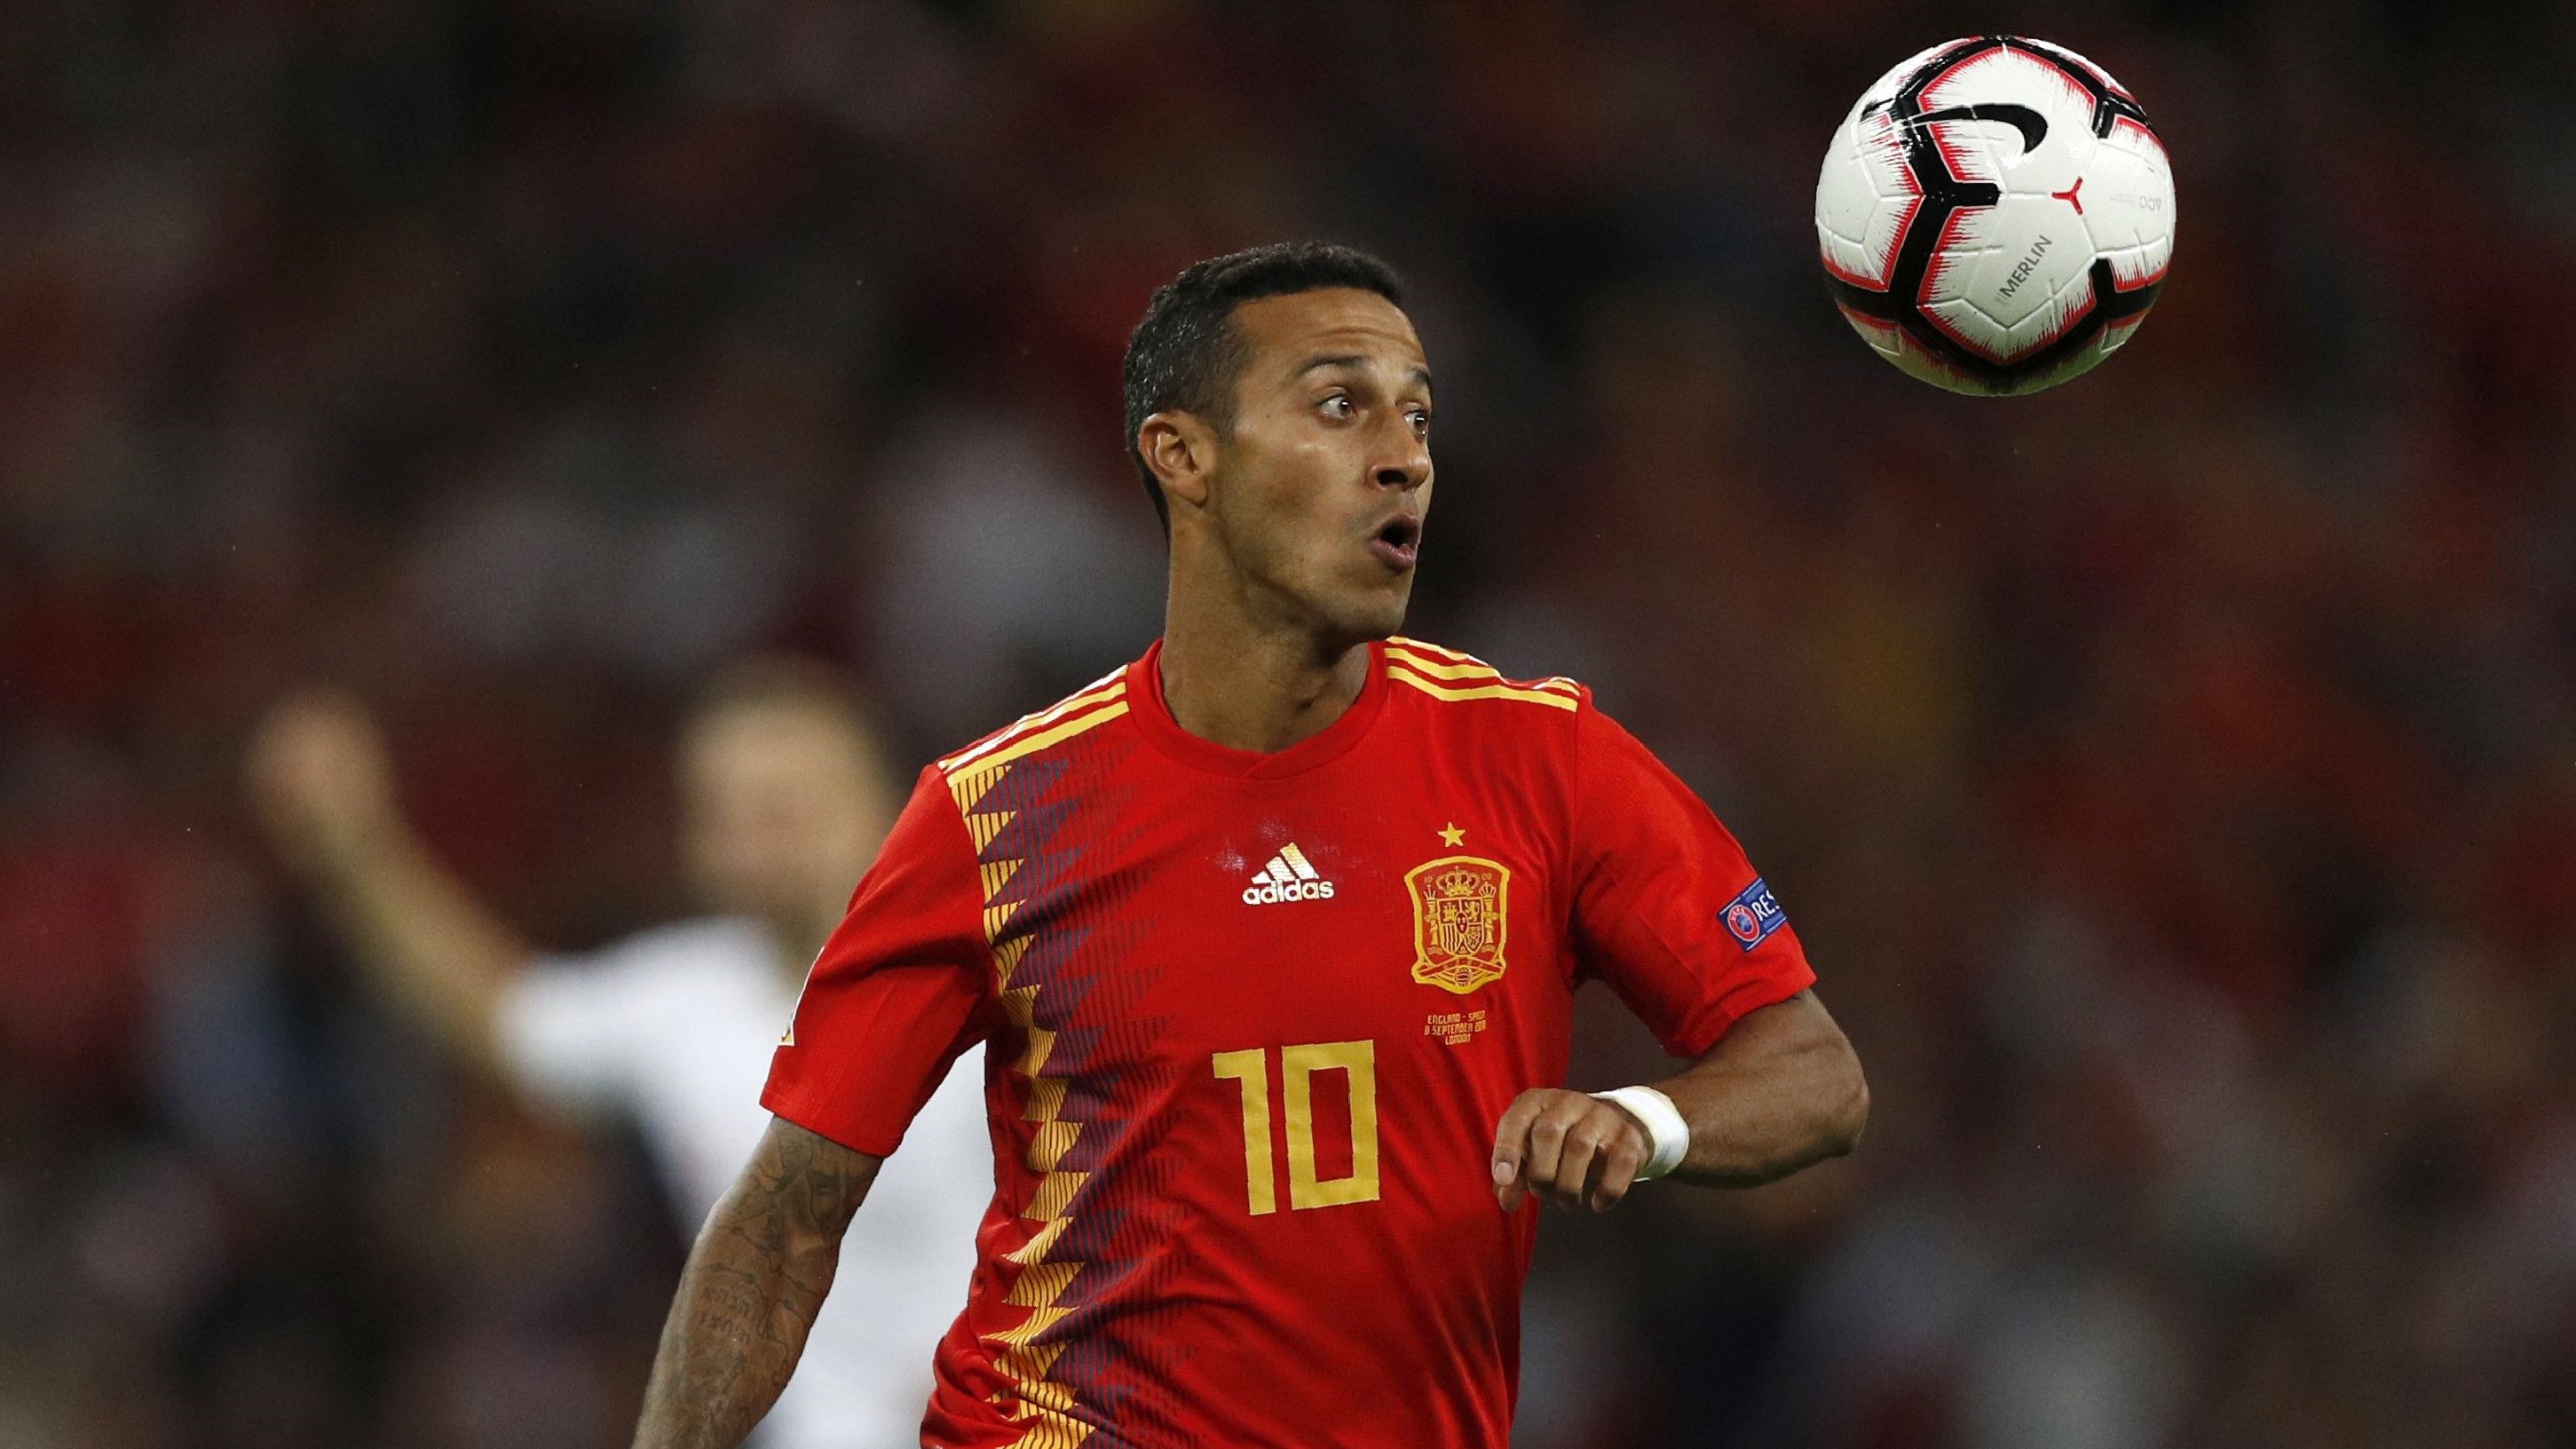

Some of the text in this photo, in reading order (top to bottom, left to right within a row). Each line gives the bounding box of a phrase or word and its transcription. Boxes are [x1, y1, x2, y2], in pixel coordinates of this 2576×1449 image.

[1999, 234, 2053, 297] MERLIN
[1242, 878, 1335, 906] adidas
[1427, 1013, 1461, 1025] ENGLAND
[1213, 1039, 1380, 1216] 10
